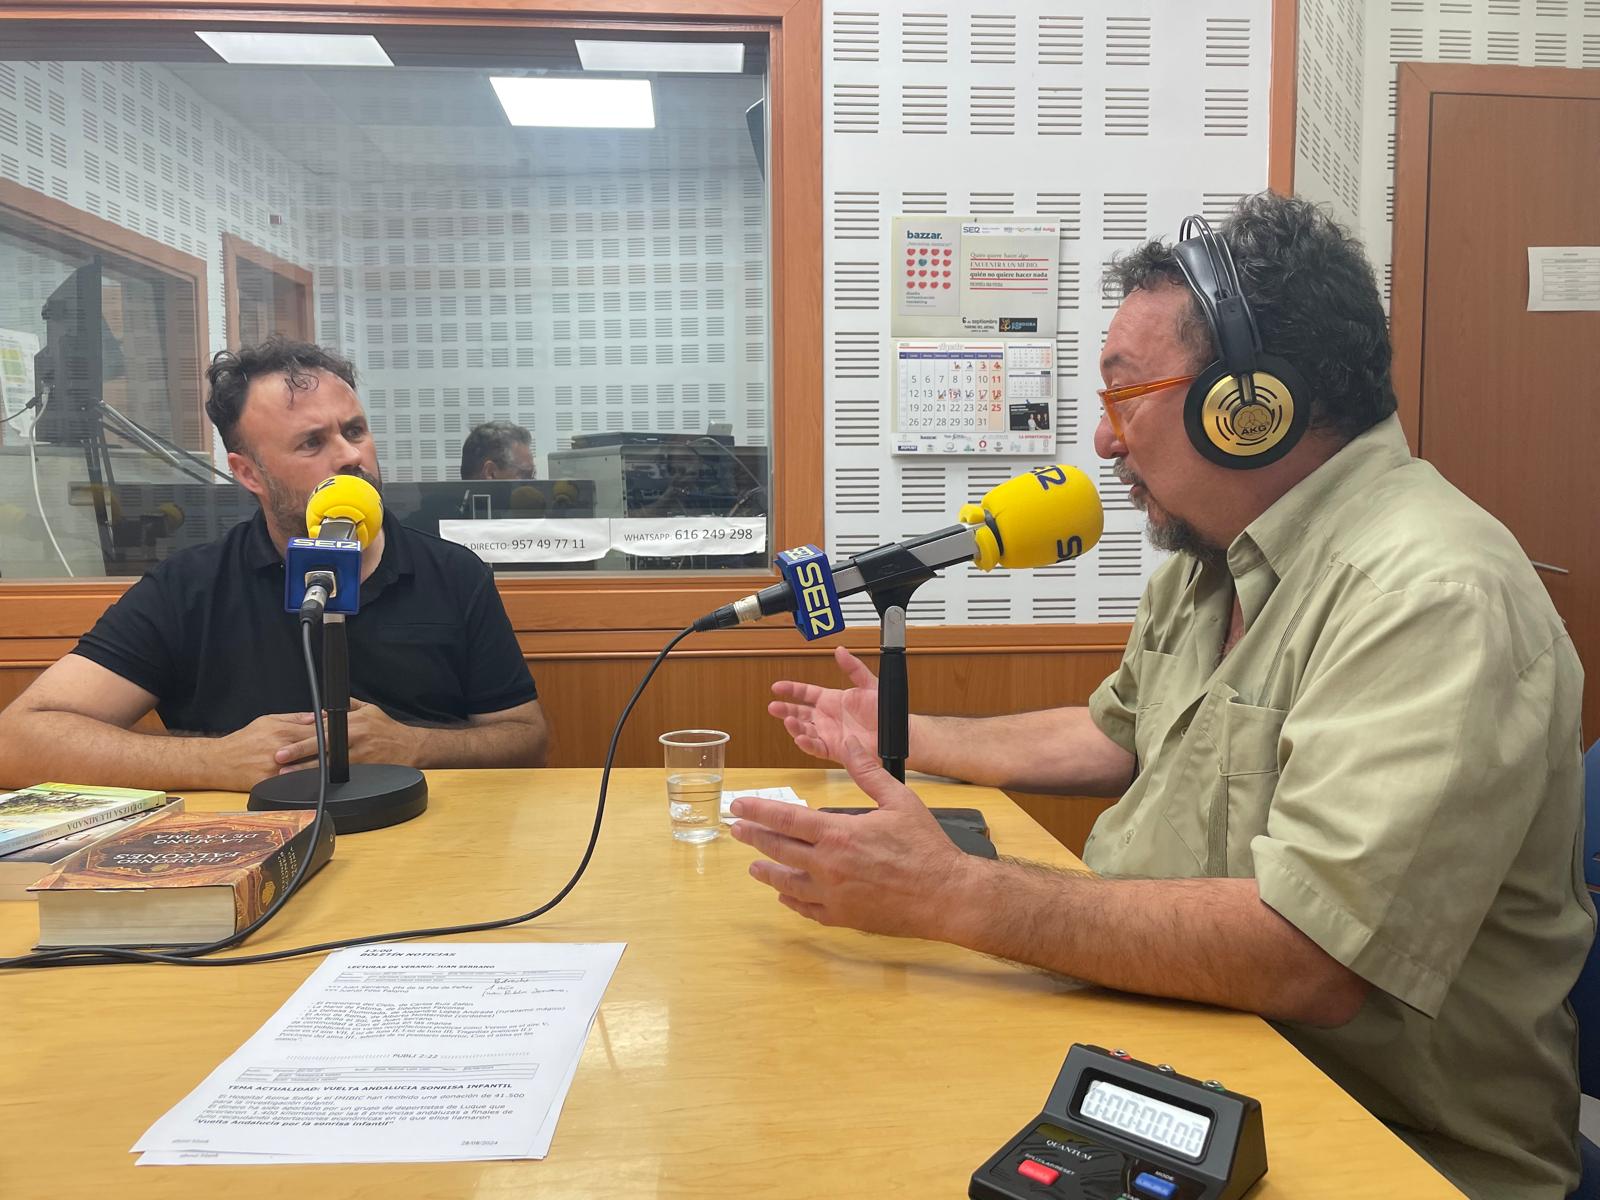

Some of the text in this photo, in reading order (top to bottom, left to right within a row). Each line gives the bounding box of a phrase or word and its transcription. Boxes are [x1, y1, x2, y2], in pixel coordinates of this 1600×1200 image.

[912, 375, 1001, 383] 5 6 7 8 9 10 11
[910, 390, 919, 398] 12
[923, 390, 933, 398] 13
[910, 404, 1001, 412] 19 20 21 22 23 24 25
[909, 418, 987, 426] 26 27 28 29 30 31
[1241, 424, 1268, 436] AKG
[675, 530, 698, 540] 616
[702, 529, 726, 539] 249
[730, 529, 753, 539] 298
[293, 538, 359, 549] SER
[511, 540, 533, 549] 957
[536, 539, 551, 549] 49
[555, 539, 568, 549] 77
[572, 538, 585, 549] 11
[796, 562, 835, 636] SER
[112, 851, 240, 859] FALCONES
[1046, 1140, 1092, 1160] QUANTUM
